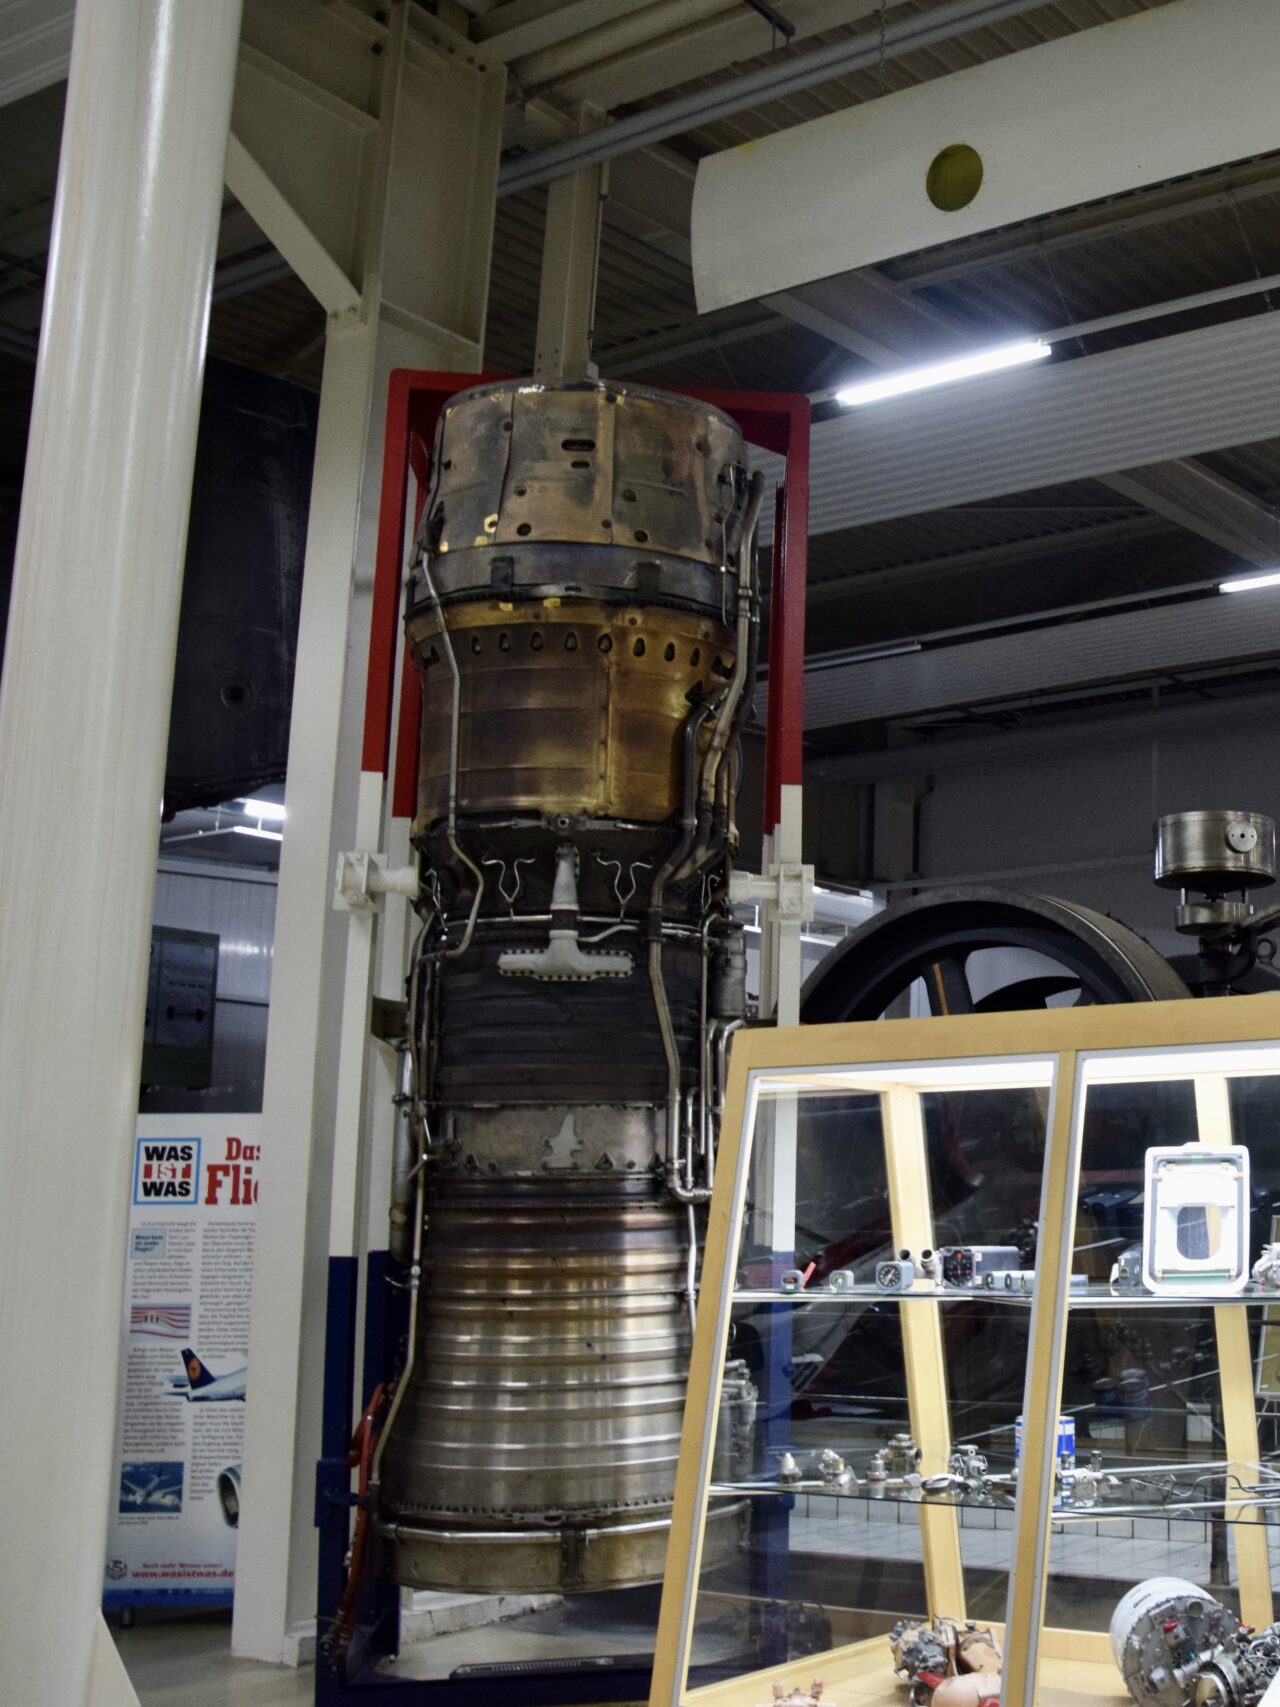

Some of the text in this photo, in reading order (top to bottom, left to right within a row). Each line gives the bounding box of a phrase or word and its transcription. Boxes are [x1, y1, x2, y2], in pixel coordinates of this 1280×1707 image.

[144, 1145, 193, 1162] WAS
[143, 1163, 192, 1179] IST
[142, 1181, 191, 1197] WAS
[131, 1569, 234, 1578] www.wasistwas.de
